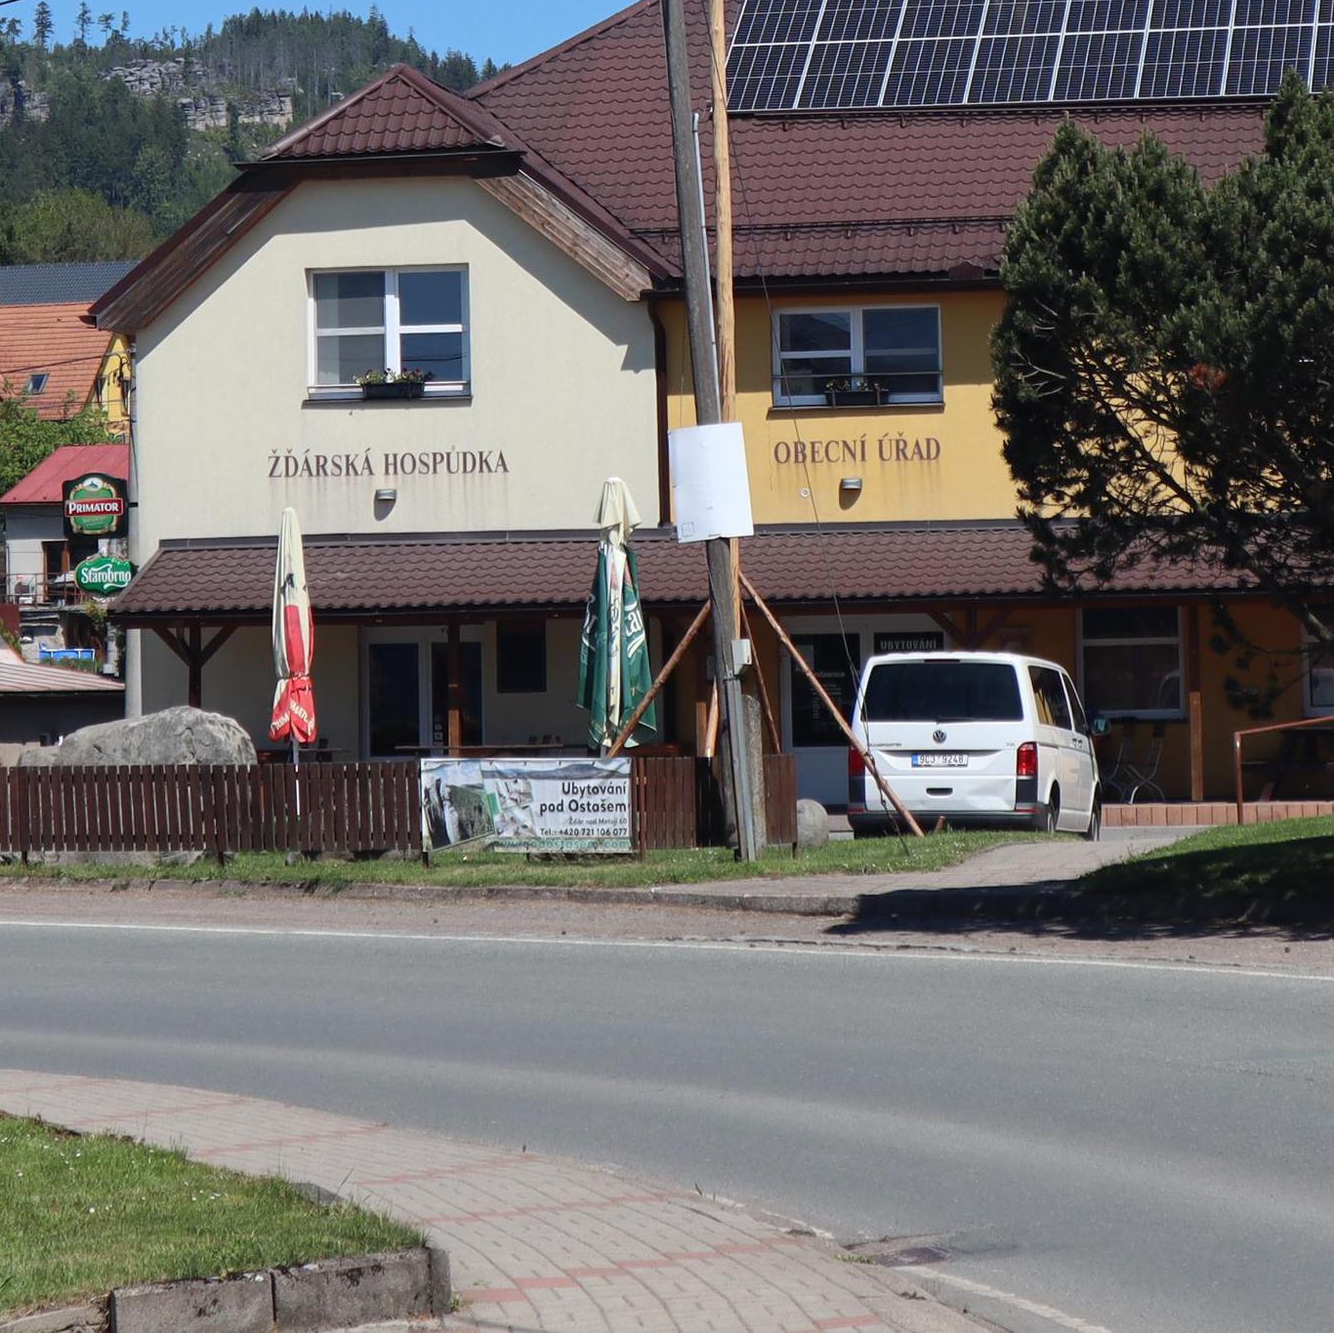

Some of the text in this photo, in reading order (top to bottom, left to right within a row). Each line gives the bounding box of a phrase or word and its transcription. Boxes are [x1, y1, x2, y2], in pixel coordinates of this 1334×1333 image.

[773, 431, 941, 464] OBECNÍ ÚŘAD
[267, 445, 510, 478] ŽĎÁRSKÁ HOSPŮDKA
[68, 502, 119, 515] PRIMATOR
[80, 565, 132, 588] Starobrno
[880, 637, 937, 650] UBYTOVÁNÍ
[561, 781, 627, 799] Ubytování
[540, 799, 627, 816] pod Ostašem
[559, 828, 579, 836] +420
[582, 828, 594, 836] 721
[597, 828, 611, 836] 106
[613, 828, 627, 836] 077
